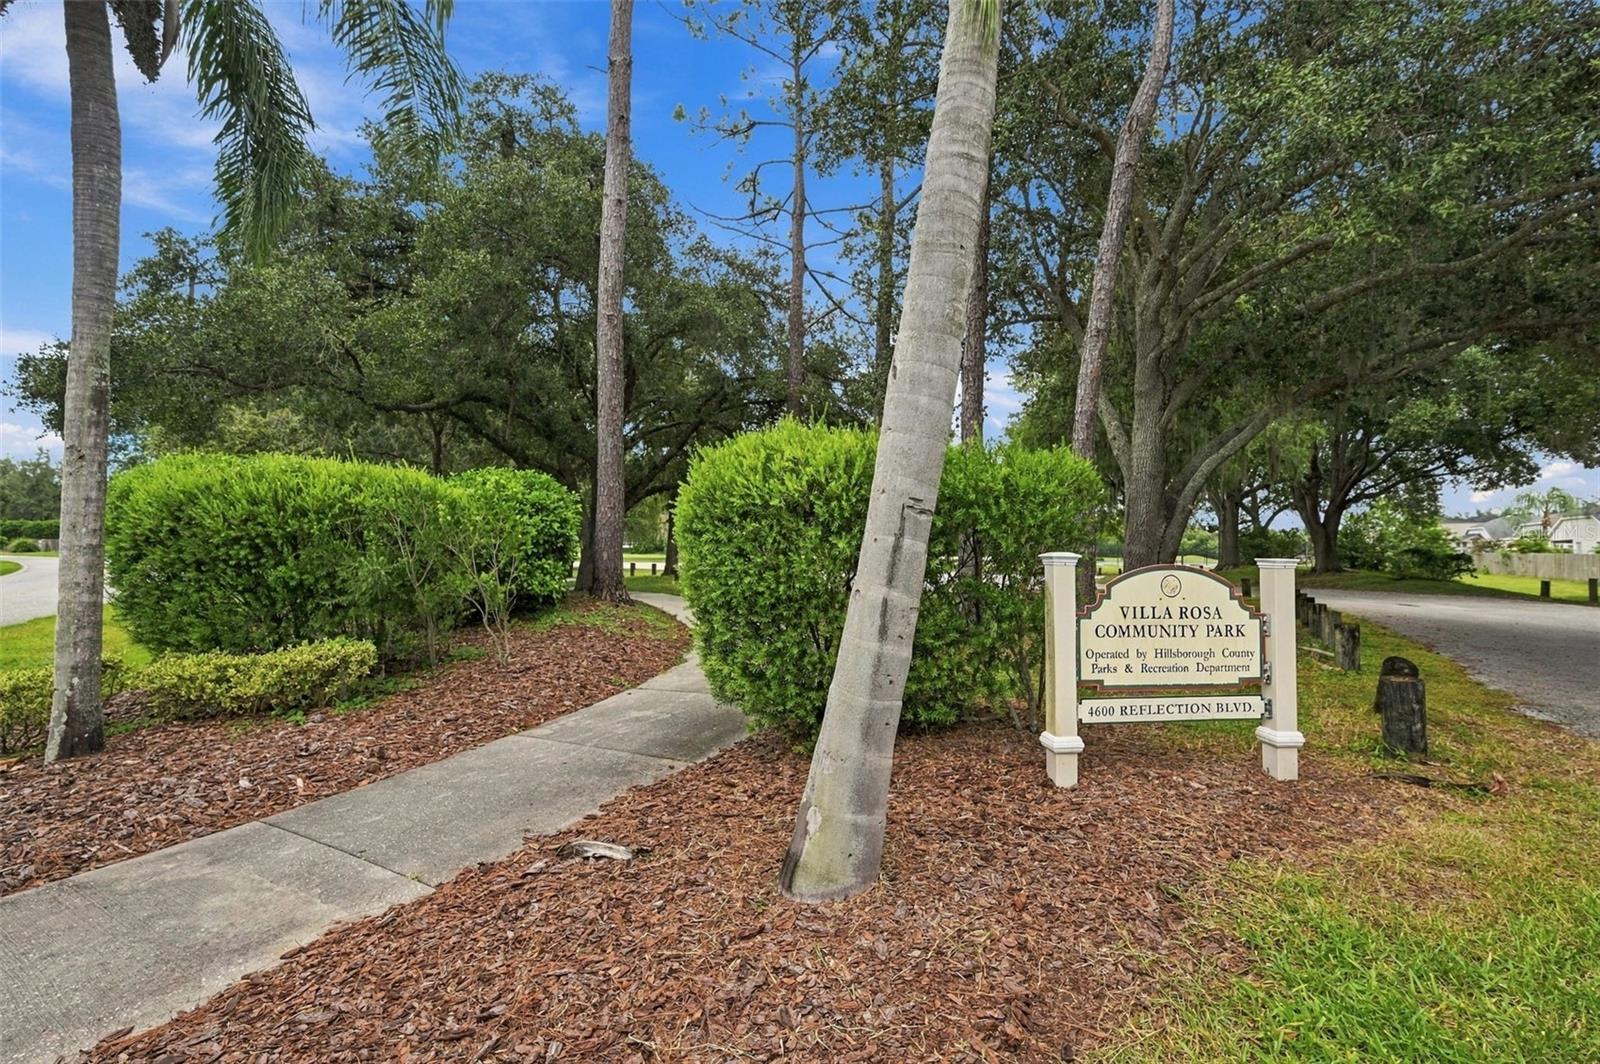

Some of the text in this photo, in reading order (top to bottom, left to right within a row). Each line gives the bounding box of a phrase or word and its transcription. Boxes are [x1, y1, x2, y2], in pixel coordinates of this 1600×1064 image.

[1119, 606, 1223, 620] VILLA ROSA
[1095, 624, 1246, 638] COMMUNITY PARK
[1085, 648, 1255, 662] Operated by Hillsborough County
[1091, 662, 1250, 675] Parks & Recreation Department
[1087, 702, 1256, 717] 4600 REFLECTION BLVD.
